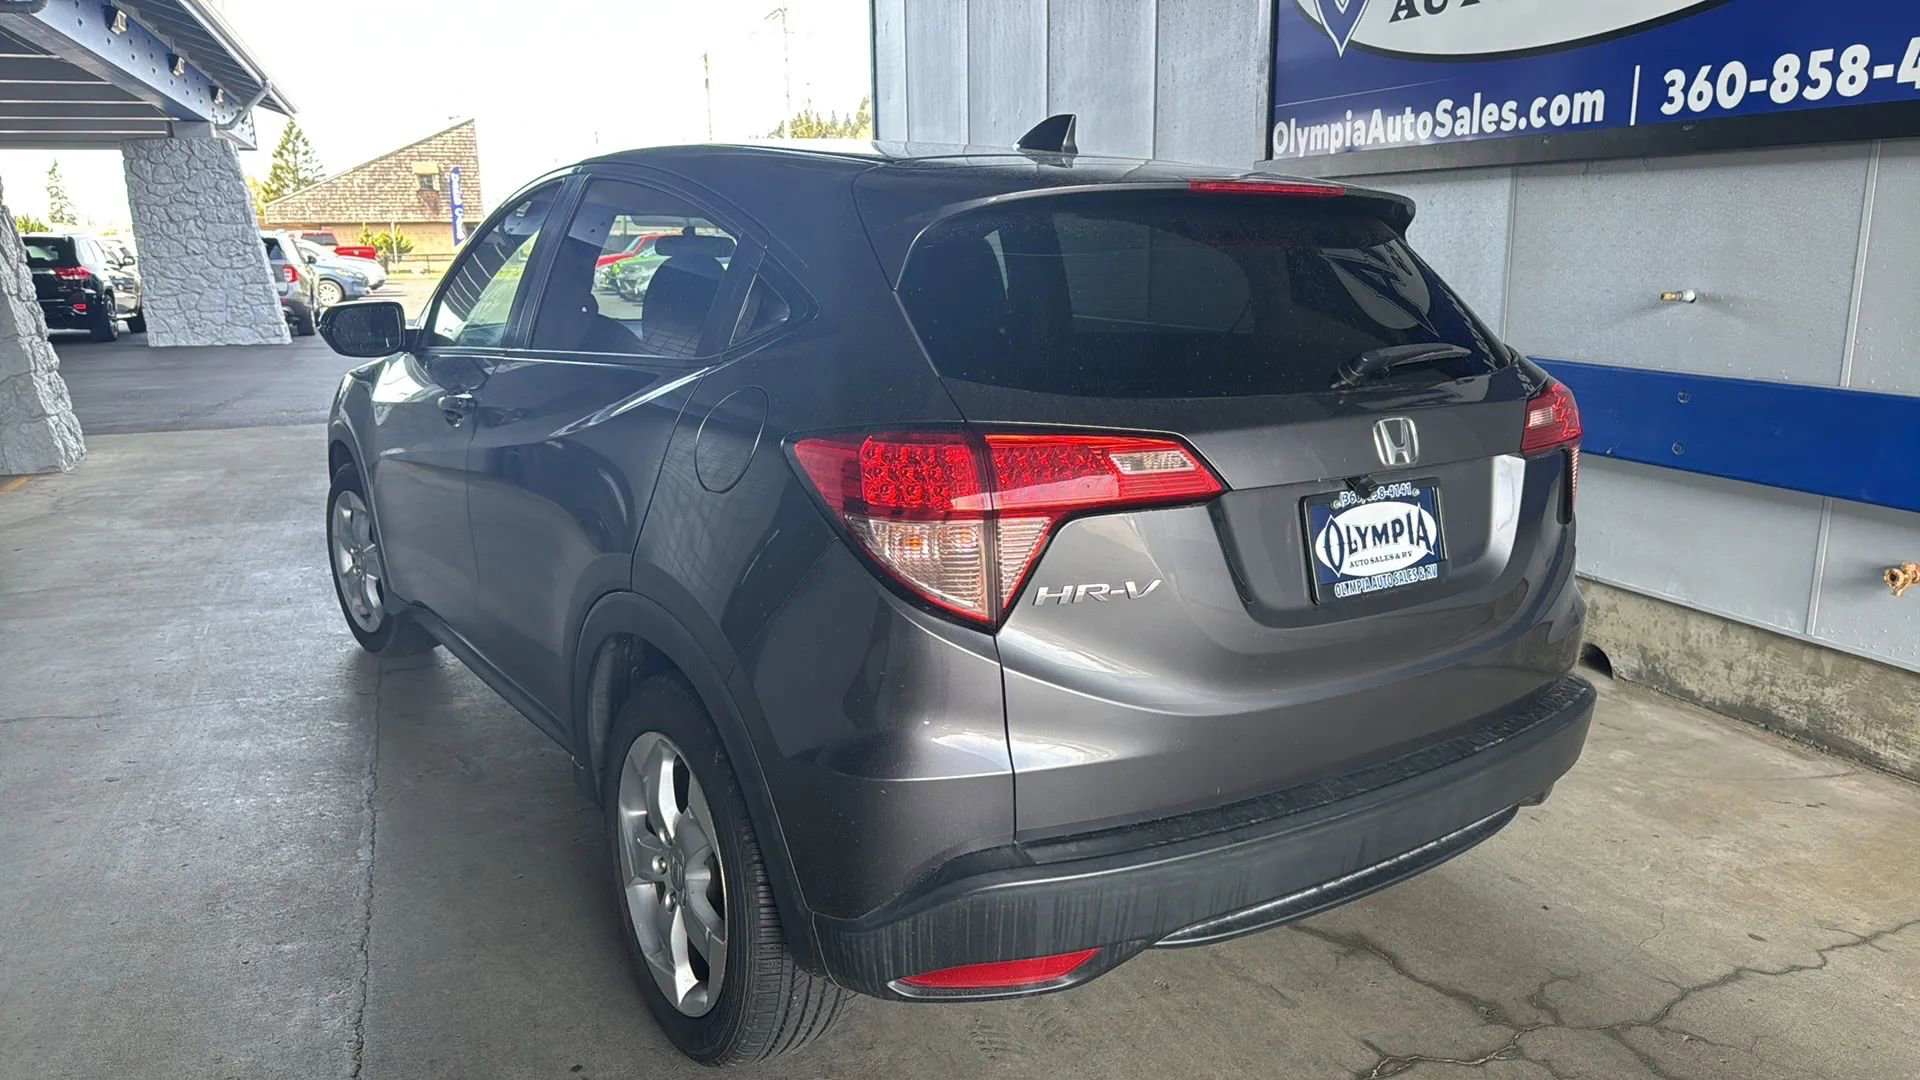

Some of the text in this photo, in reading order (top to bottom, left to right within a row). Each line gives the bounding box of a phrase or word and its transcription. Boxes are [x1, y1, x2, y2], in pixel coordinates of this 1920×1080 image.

[1389, 0, 1481, 23] AU
[1272, 36, 1920, 158] OlympiaAutoSales.com 360-858-4
[1323, 504, 1434, 577] OLYMPIA
[1349, 550, 1413, 569] AUTO SALES & RV
[1032, 578, 1162, 606] HR-V
[1334, 563, 1438, 598] OLYMPIA AUTO SALES & RV
